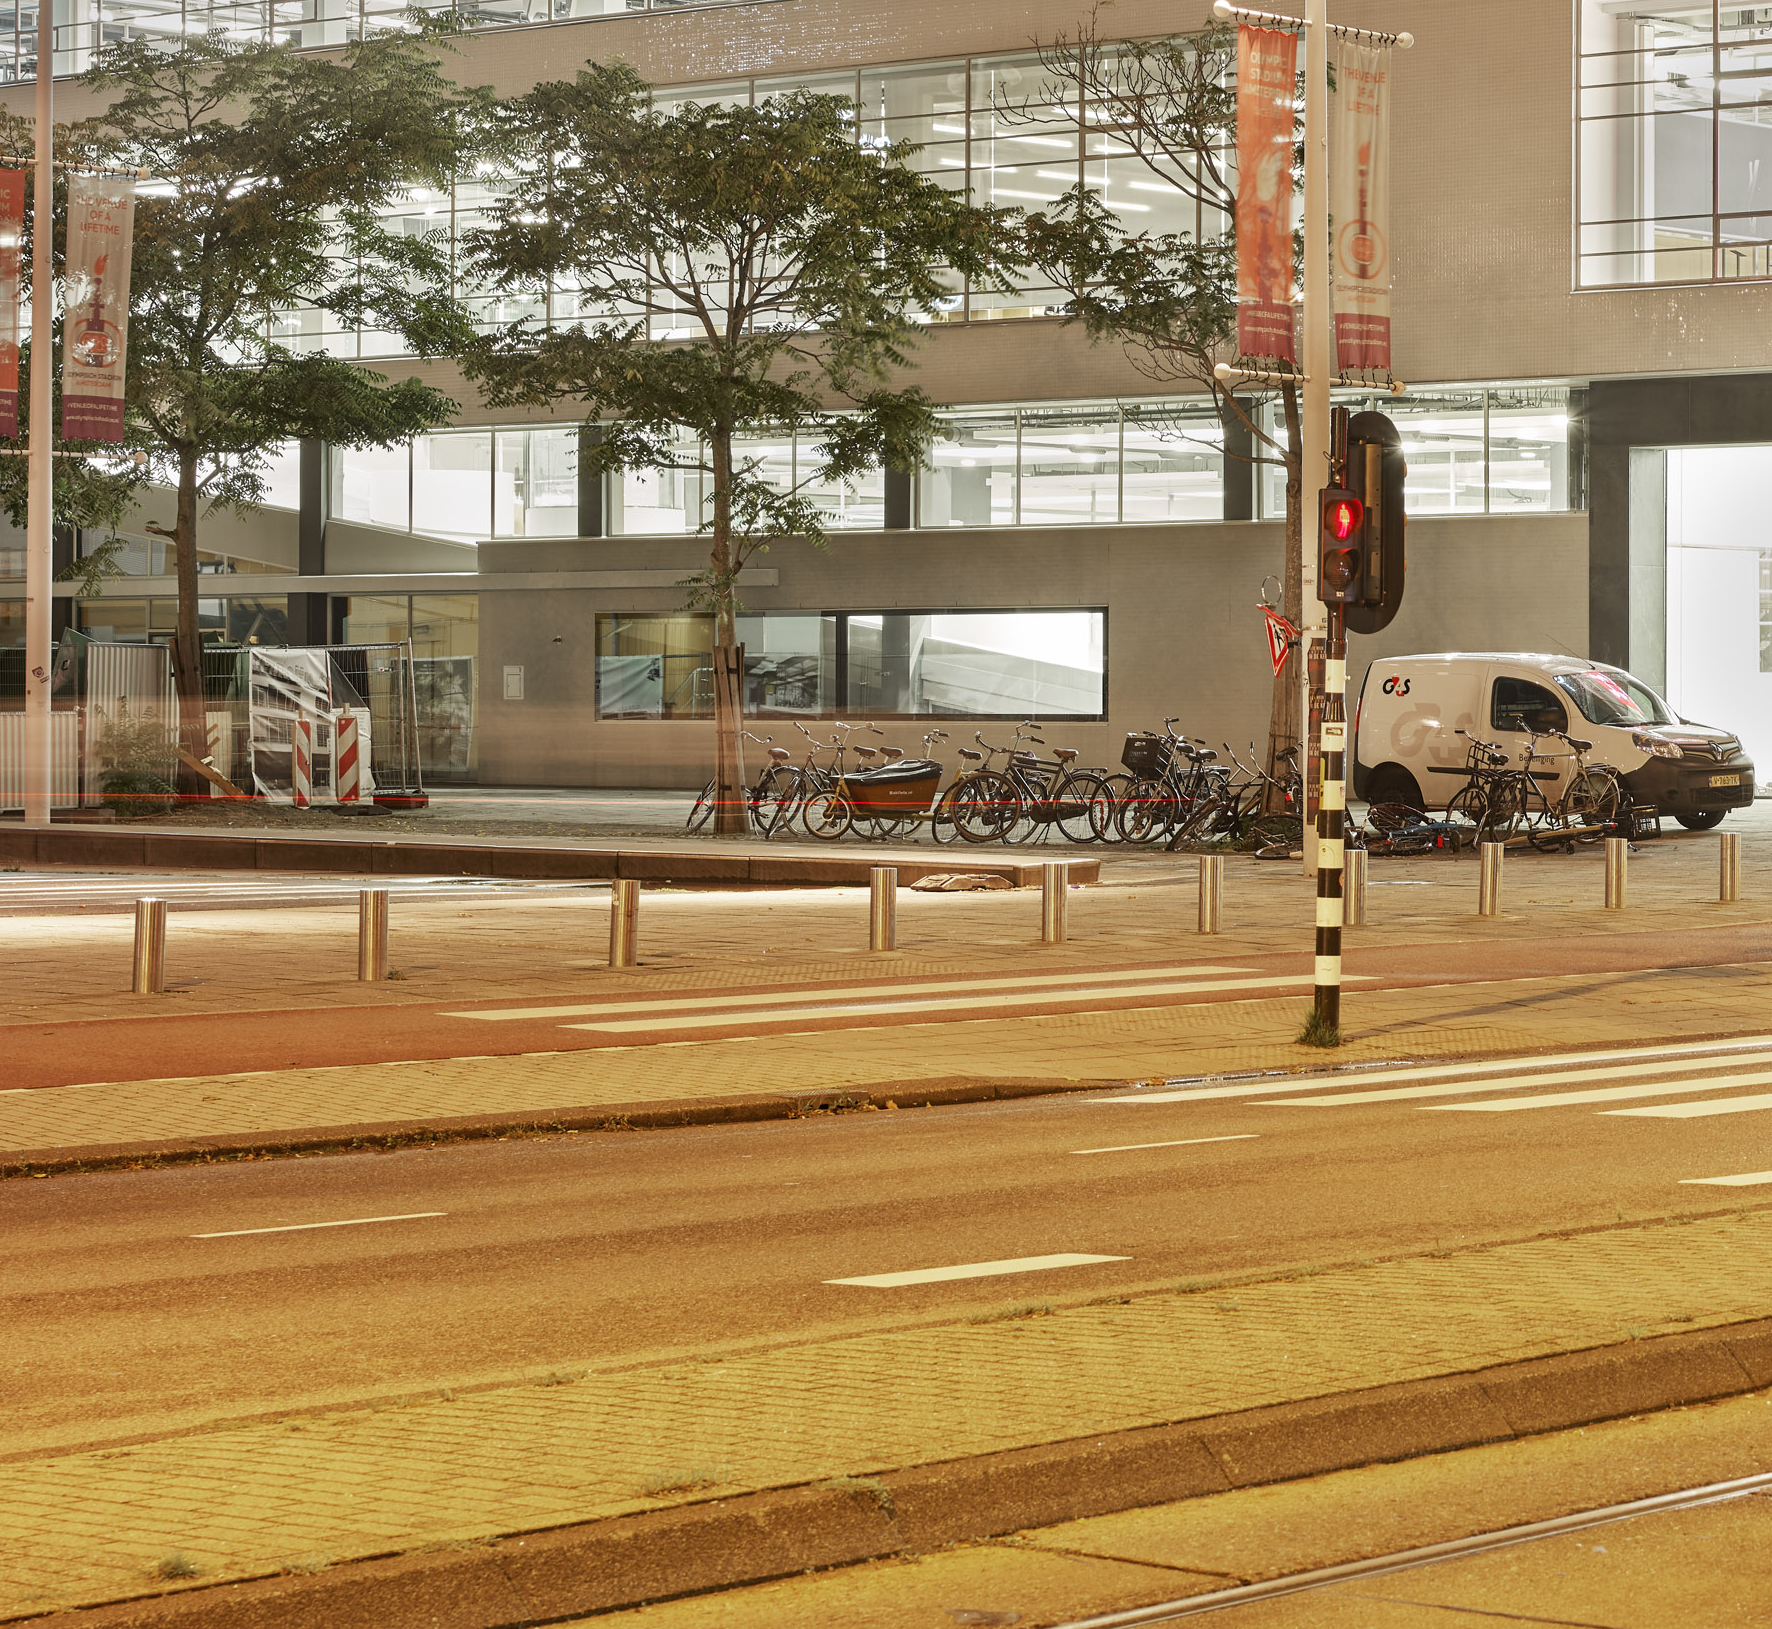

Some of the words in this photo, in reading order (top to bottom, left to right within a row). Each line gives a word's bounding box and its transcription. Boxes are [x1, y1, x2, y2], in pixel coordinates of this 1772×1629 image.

[1250, 52, 1288, 68] OLYMPIC
[90, 209, 103, 221] OF
[80, 221, 121, 236] LIFETIME
[1382, 676, 1411, 697] G4S
[1390, 702, 1474, 766] G4S
